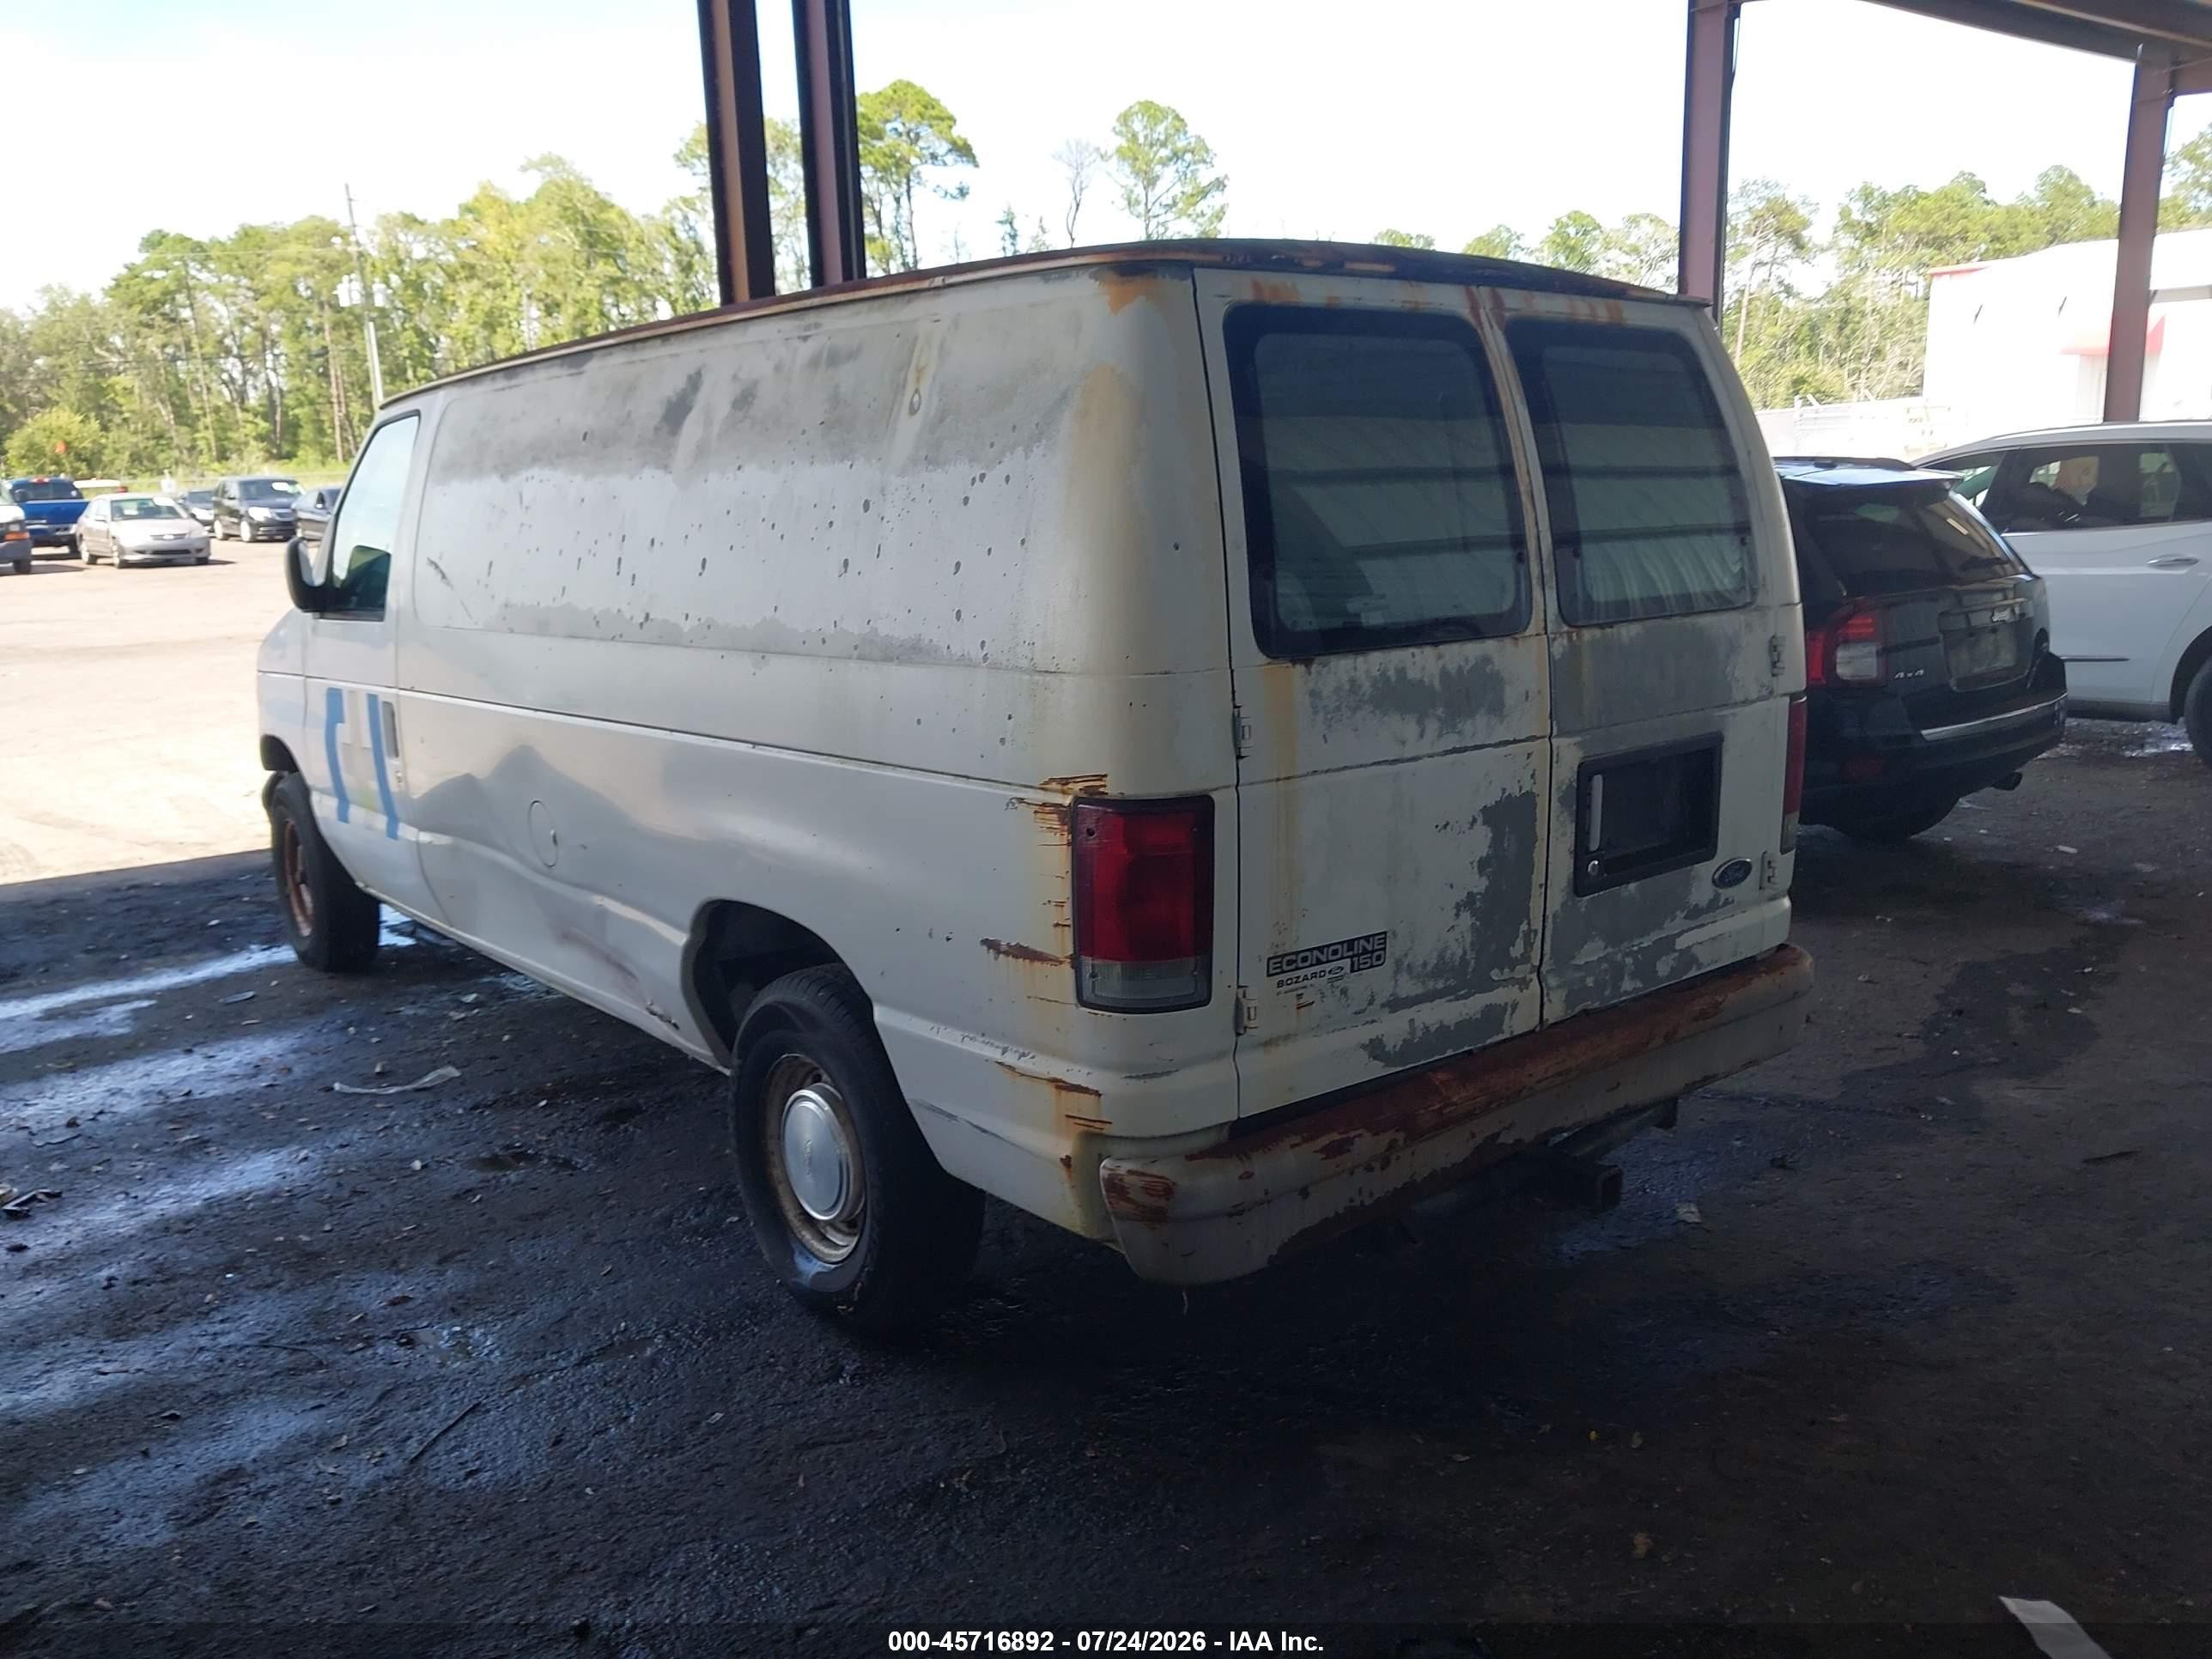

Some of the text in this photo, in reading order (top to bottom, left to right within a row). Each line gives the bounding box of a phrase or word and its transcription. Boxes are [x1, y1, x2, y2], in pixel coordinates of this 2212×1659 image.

[1268, 934, 1385, 974] ECONOLINE
[1352, 951, 1385, 971] 150
[1277, 969, 1327, 988] BOZARD
